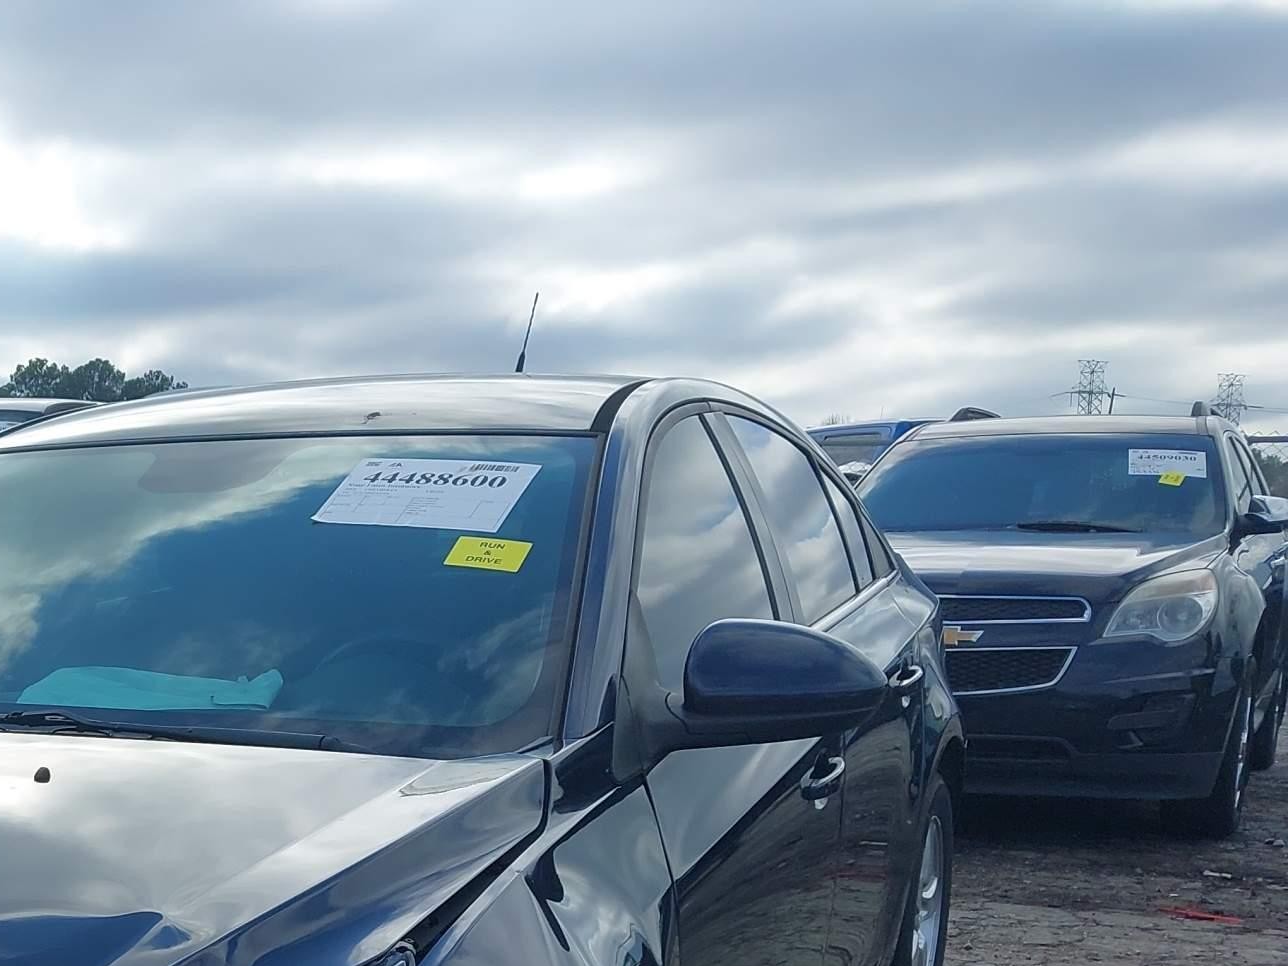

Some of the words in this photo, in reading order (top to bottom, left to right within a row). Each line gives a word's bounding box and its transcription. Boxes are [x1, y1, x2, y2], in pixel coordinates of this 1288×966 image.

[363, 471, 508, 489] 44488600
[479, 541, 506, 550] RUN
[465, 555, 503, 565] DRIVE
